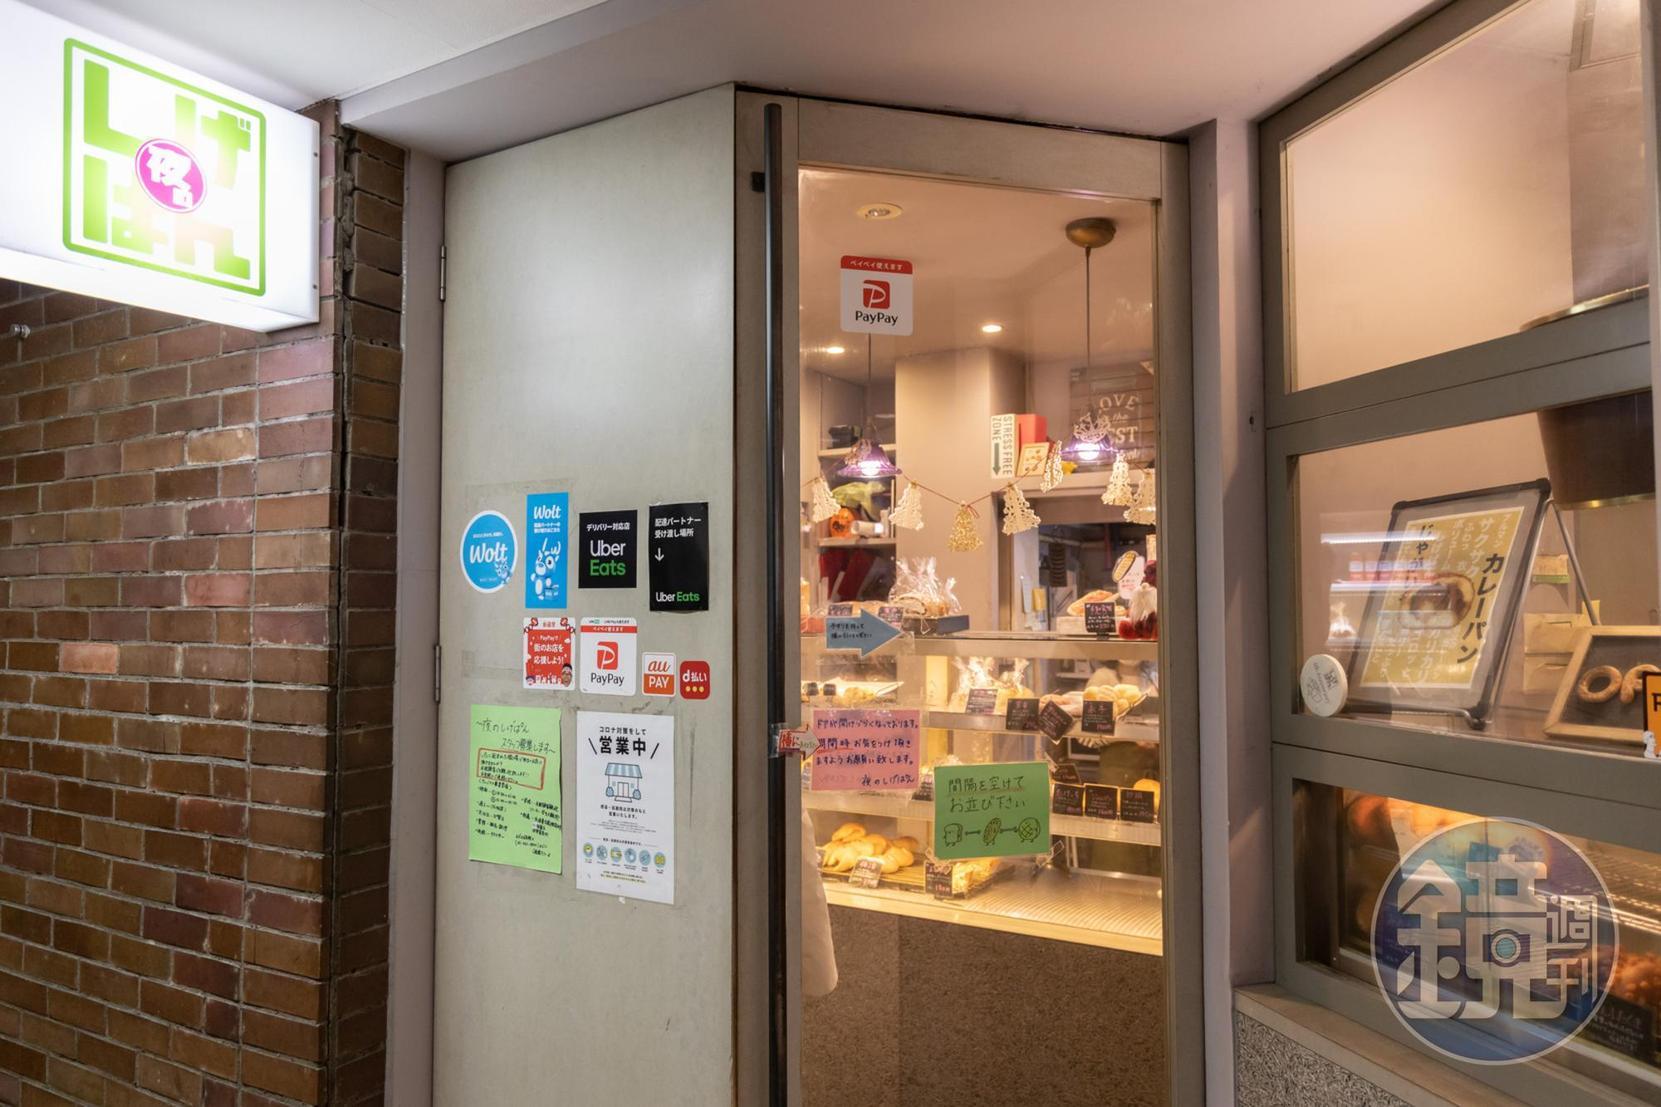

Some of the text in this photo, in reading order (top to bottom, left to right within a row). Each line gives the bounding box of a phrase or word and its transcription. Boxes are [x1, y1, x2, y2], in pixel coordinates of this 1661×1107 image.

[855, 310, 898, 326] PayPay
[1100, 393, 1139, 411] OVE
[992, 416, 1002, 440] ZONE
[1003, 452, 1013, 475] FREE
[533, 505, 561, 519] Wolt
[586, 522, 631, 532] デリバリー対応店
[654, 517, 702, 527] 配達パートナー
[654, 528, 694, 539] 受け渡し場所
[470, 542, 508, 564] Wolt
[590, 540, 626, 557] Uber
[1465, 516, 1496, 577] サクサク
[590, 559, 626, 576] Eats
[655, 591, 701, 602] Uber Eats
[1456, 553, 1505, 663] カレーパン
[648, 660, 671, 672] au
[590, 672, 624, 686] PayPay
[649, 676, 670, 689] PAY
[682, 669, 707, 683] d払い
[599, 726, 647, 736] コロナ対策をして
[599, 735, 647, 757] 営業中
[948, 776, 1024, 793] 間隔を空けて
[950, 795, 1026, 813] お並び下さい
